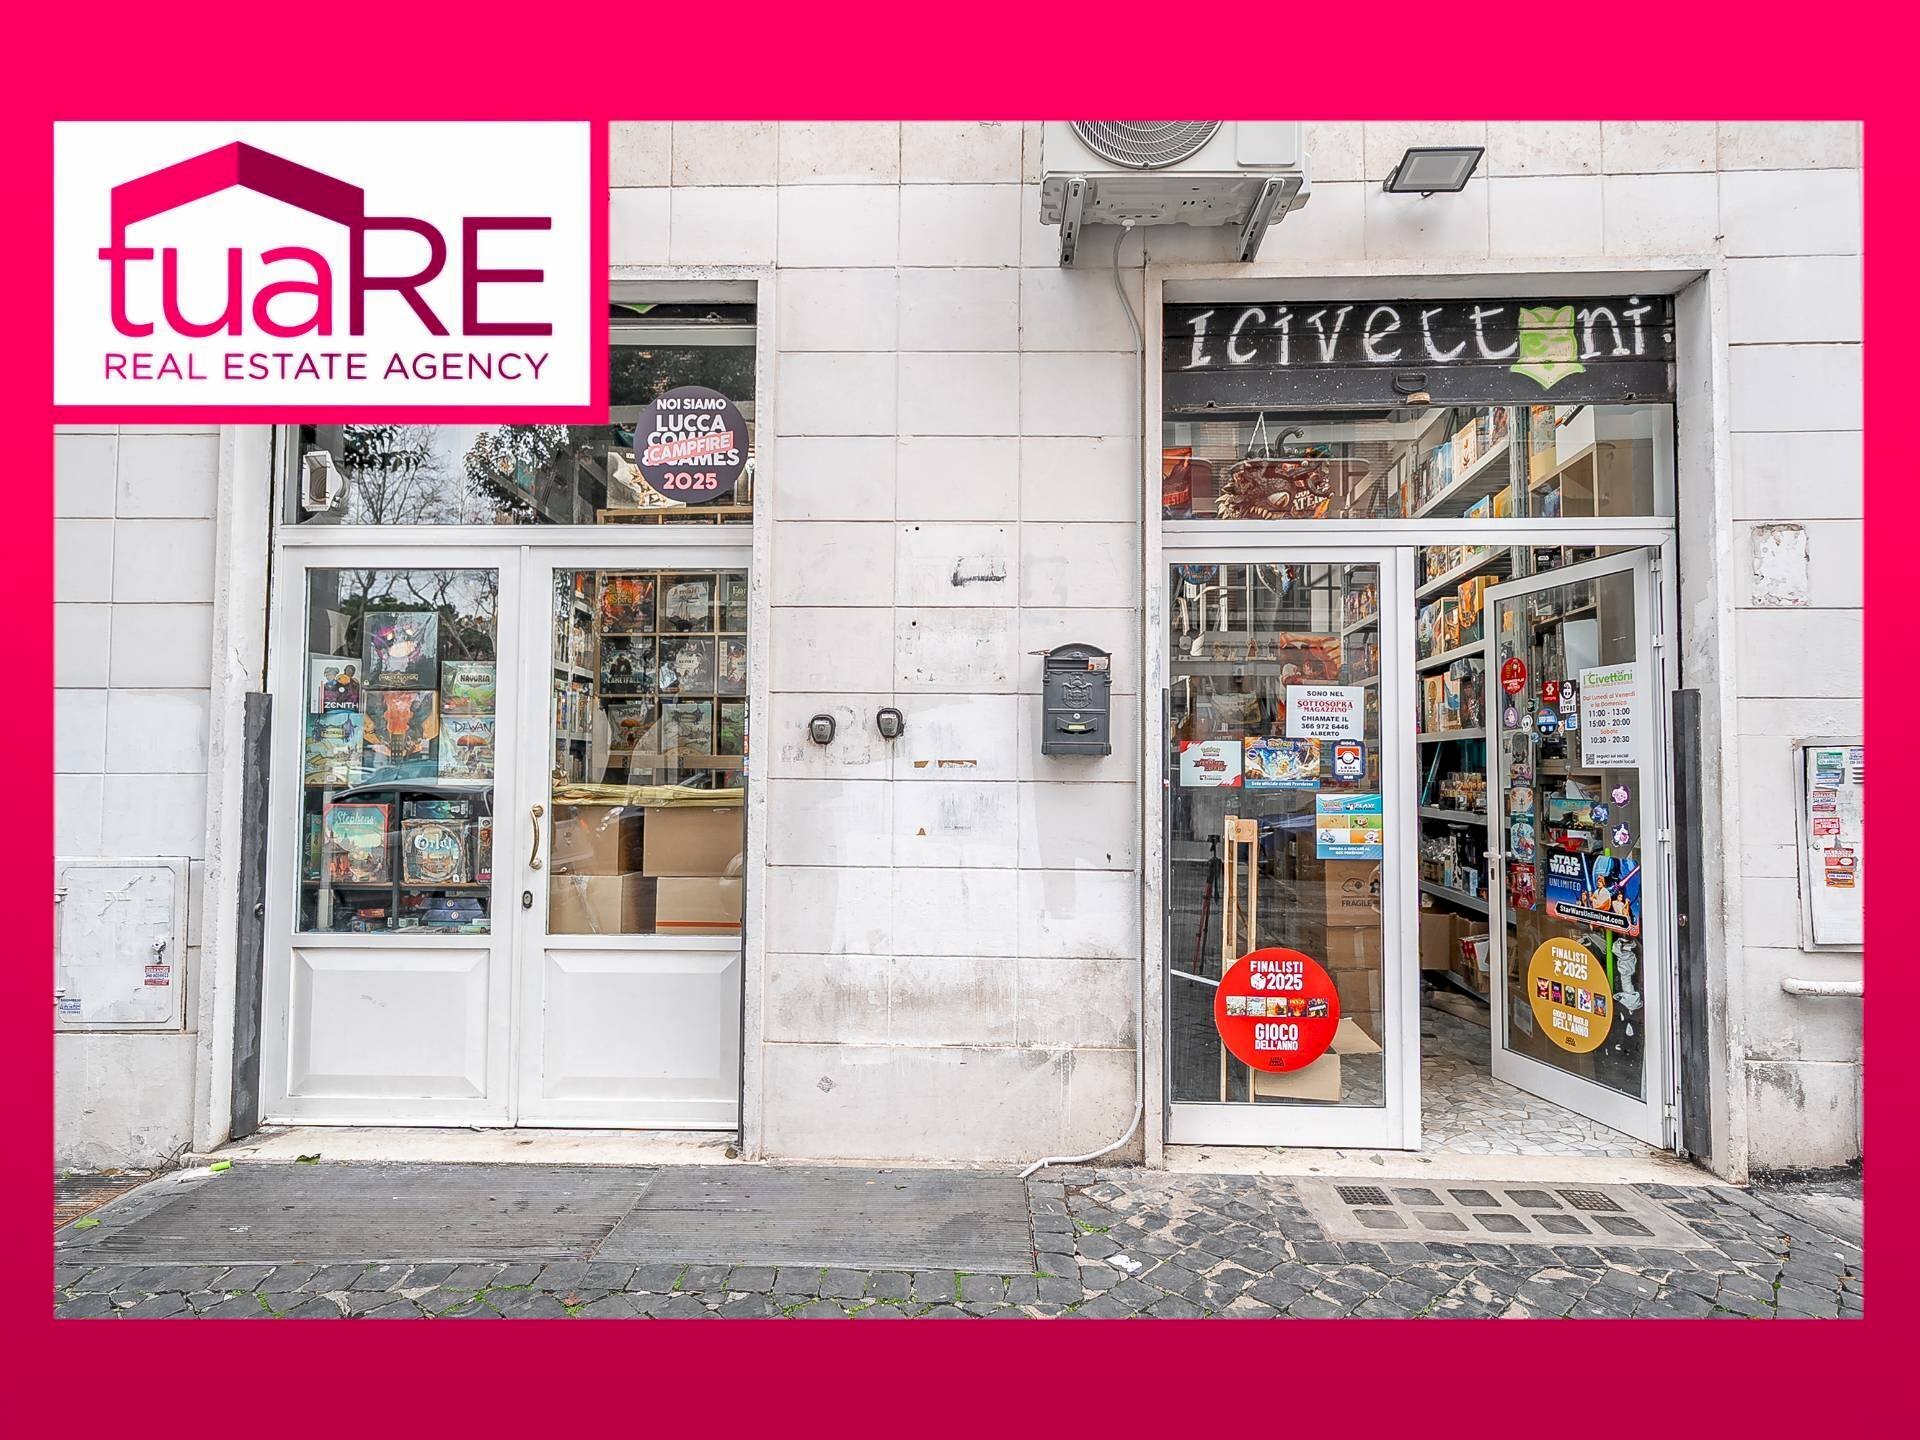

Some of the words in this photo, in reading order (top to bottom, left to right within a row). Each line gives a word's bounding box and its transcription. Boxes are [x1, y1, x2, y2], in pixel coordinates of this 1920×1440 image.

[656, 398, 680, 410] NOI
[683, 398, 727, 410] SIAMO
[656, 414, 726, 432] LUCCA
[649, 434, 731, 462] CAMPFIRE
[663, 472, 718, 490] 2025
[1588, 670, 1633, 685] Civettoni
[324, 701, 359, 709] ZENITH
[1588, 709, 1606, 718] 11:00
[1612, 707, 1631, 716] 13:00
[453, 720, 495, 735] DEWAN
[1588, 719, 1606, 728] 15:00
[1612, 718, 1631, 727] 20:00
[1590, 736, 1607, 744] 10:30
[1612, 735, 1630, 743] 20:30
[1549, 854, 1581, 867] STAR
[1550, 863, 1581, 876] WARS
[1549, 877, 1581, 891] UNLIMITED
[1341, 899, 1372, 907] FRAGILE
[1559, 904, 1624, 926] StarWarsUnlimited.com
[1551, 946, 1588, 965] FINALISTI
[1250, 960, 1303, 974] FINALISTI
[1562, 961, 1588, 980] 2025
[1266, 974, 1303, 991] 2025
[1552, 1009, 1567, 1019] GIOCO
[1255, 1023, 1299, 1041] GIOCO
[1552, 1017, 1589, 1038] DELL'ANNO
[1255, 1039, 1299, 1051] DELL'ANNO
